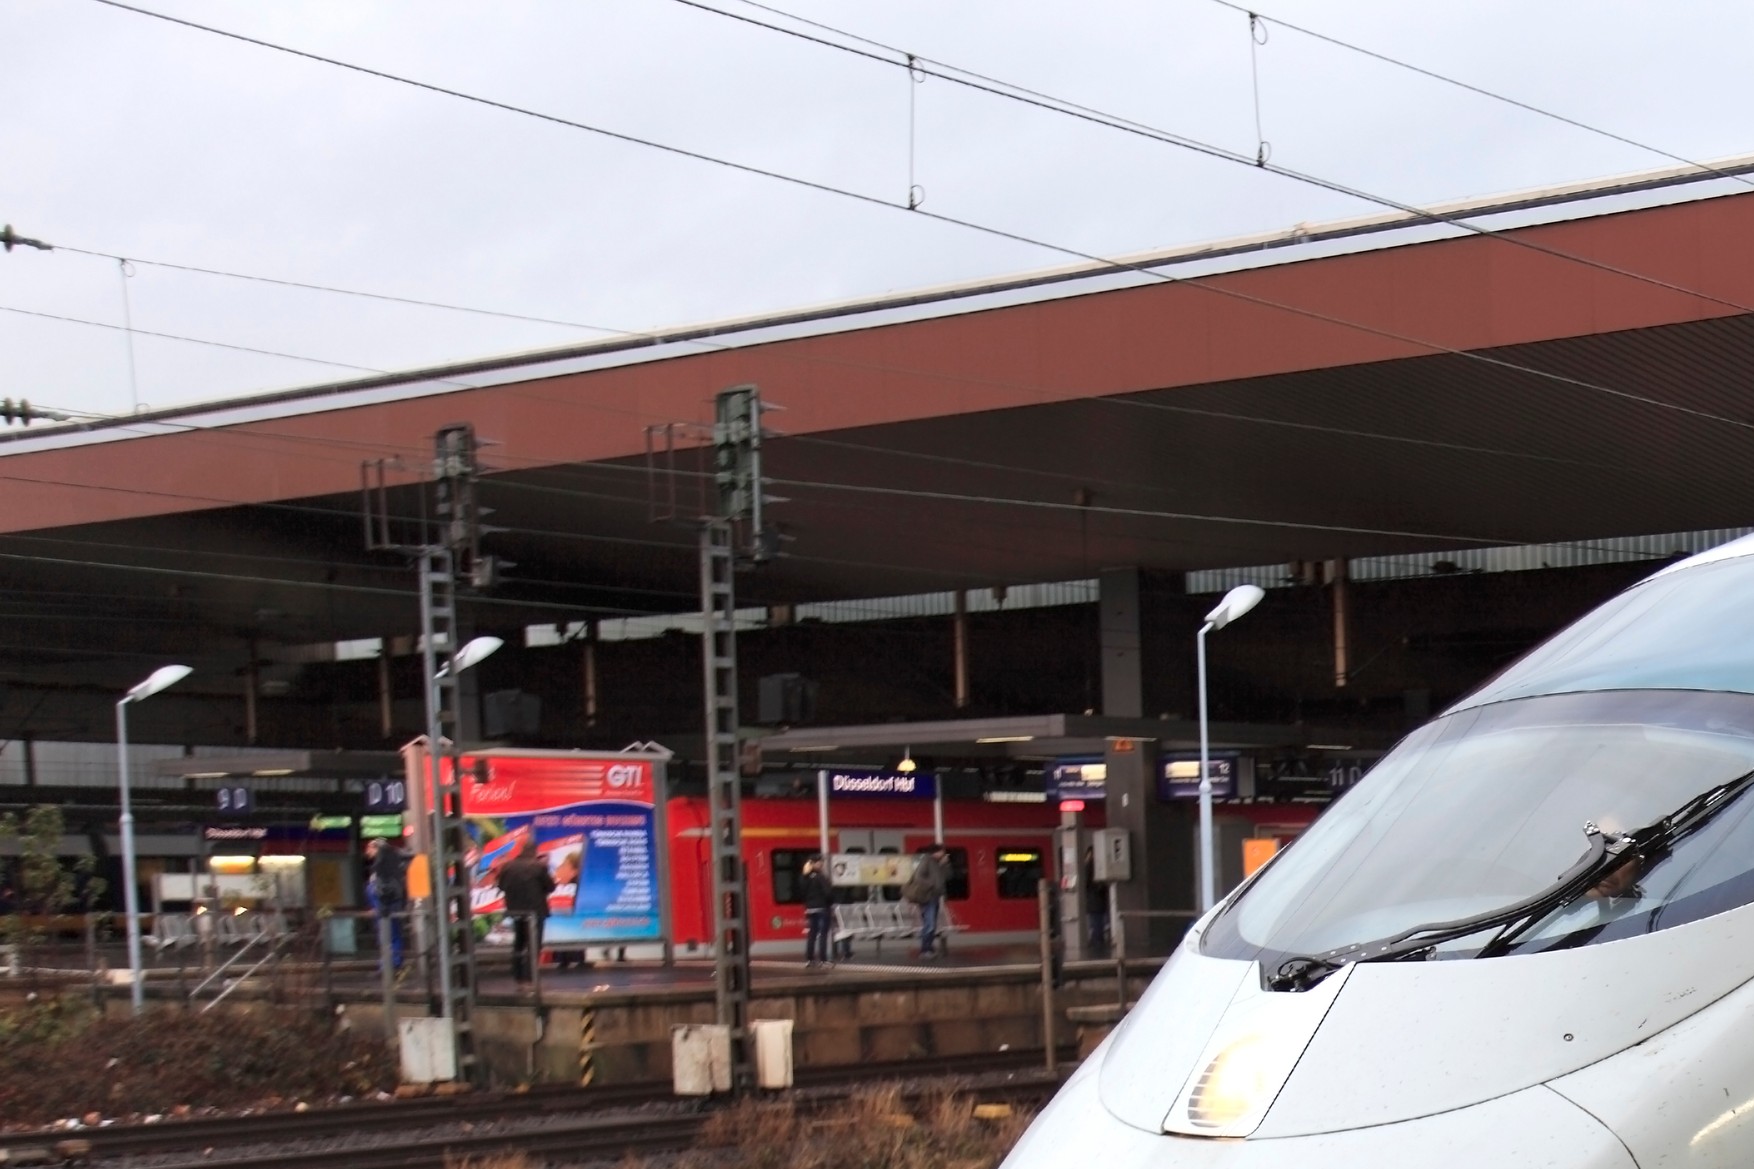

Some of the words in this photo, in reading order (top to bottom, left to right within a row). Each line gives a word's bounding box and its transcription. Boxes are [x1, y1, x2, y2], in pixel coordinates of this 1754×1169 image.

[607, 764, 643, 788] GTI
[833, 774, 894, 791] Düsseldorf
[894, 776, 915, 792] Hbf
[217, 788, 229, 810] 9
[385, 781, 404, 805] 10
